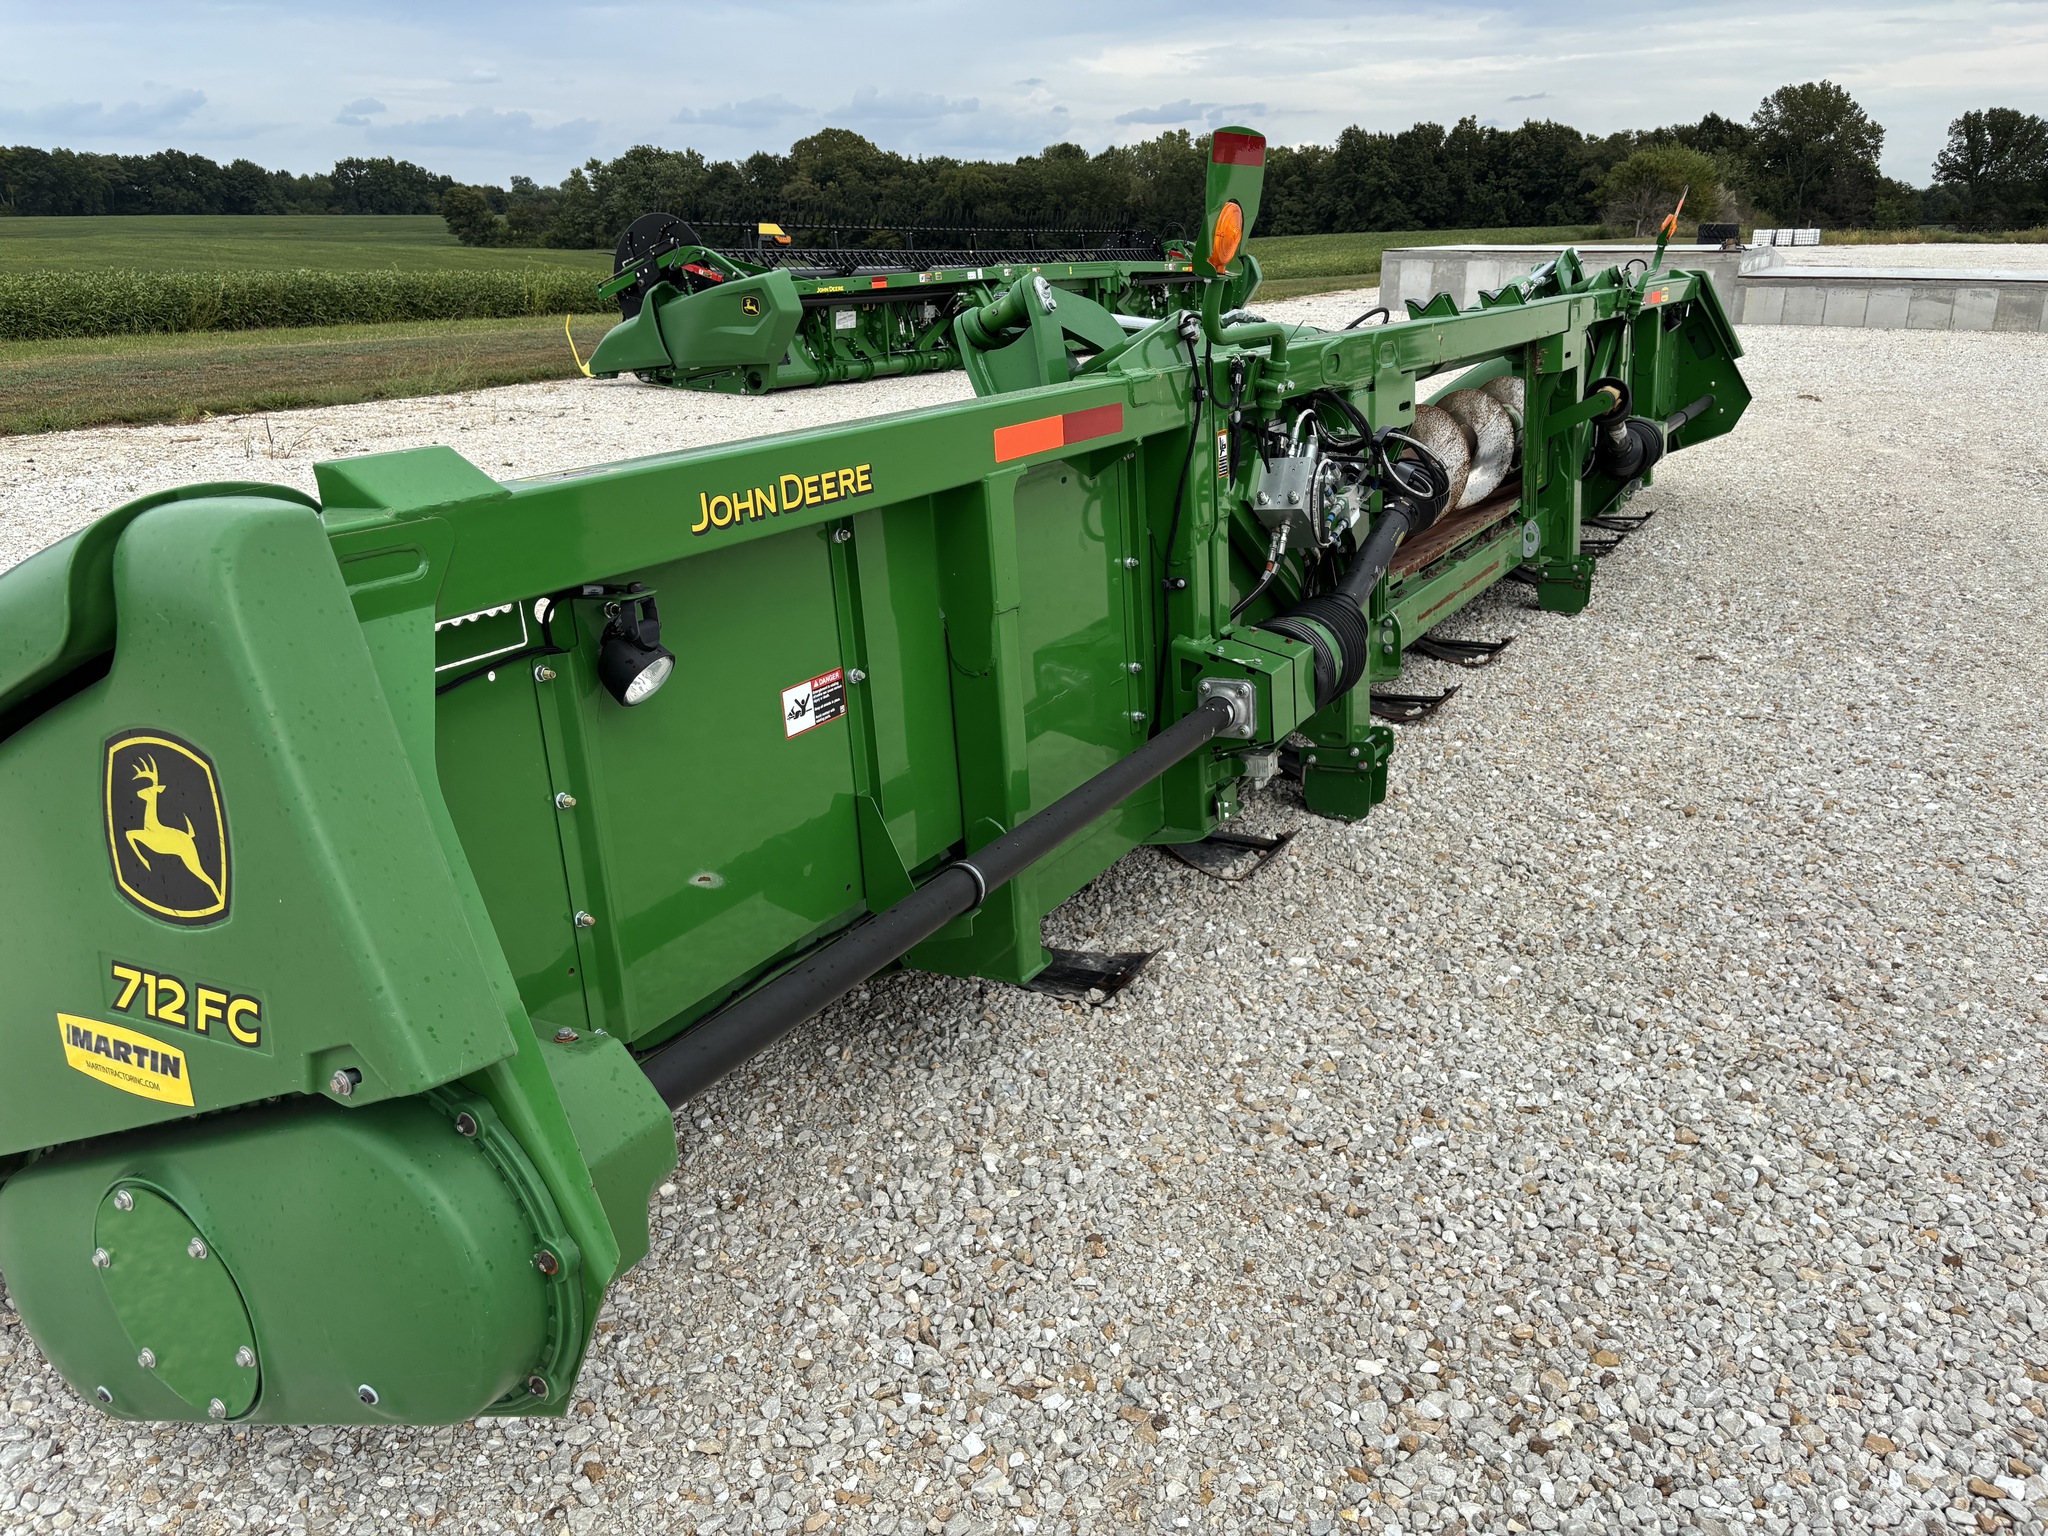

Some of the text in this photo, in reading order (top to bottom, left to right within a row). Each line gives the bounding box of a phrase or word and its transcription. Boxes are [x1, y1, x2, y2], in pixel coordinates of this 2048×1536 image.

[691, 463, 874, 536] JOHN DEERE
[818, 672, 840, 685] DANGER
[111, 960, 262, 1048] 712 FC
[66, 1023, 181, 1080] MARTIN
[85, 1060, 161, 1091] MARTINTRACTORINC.COM
